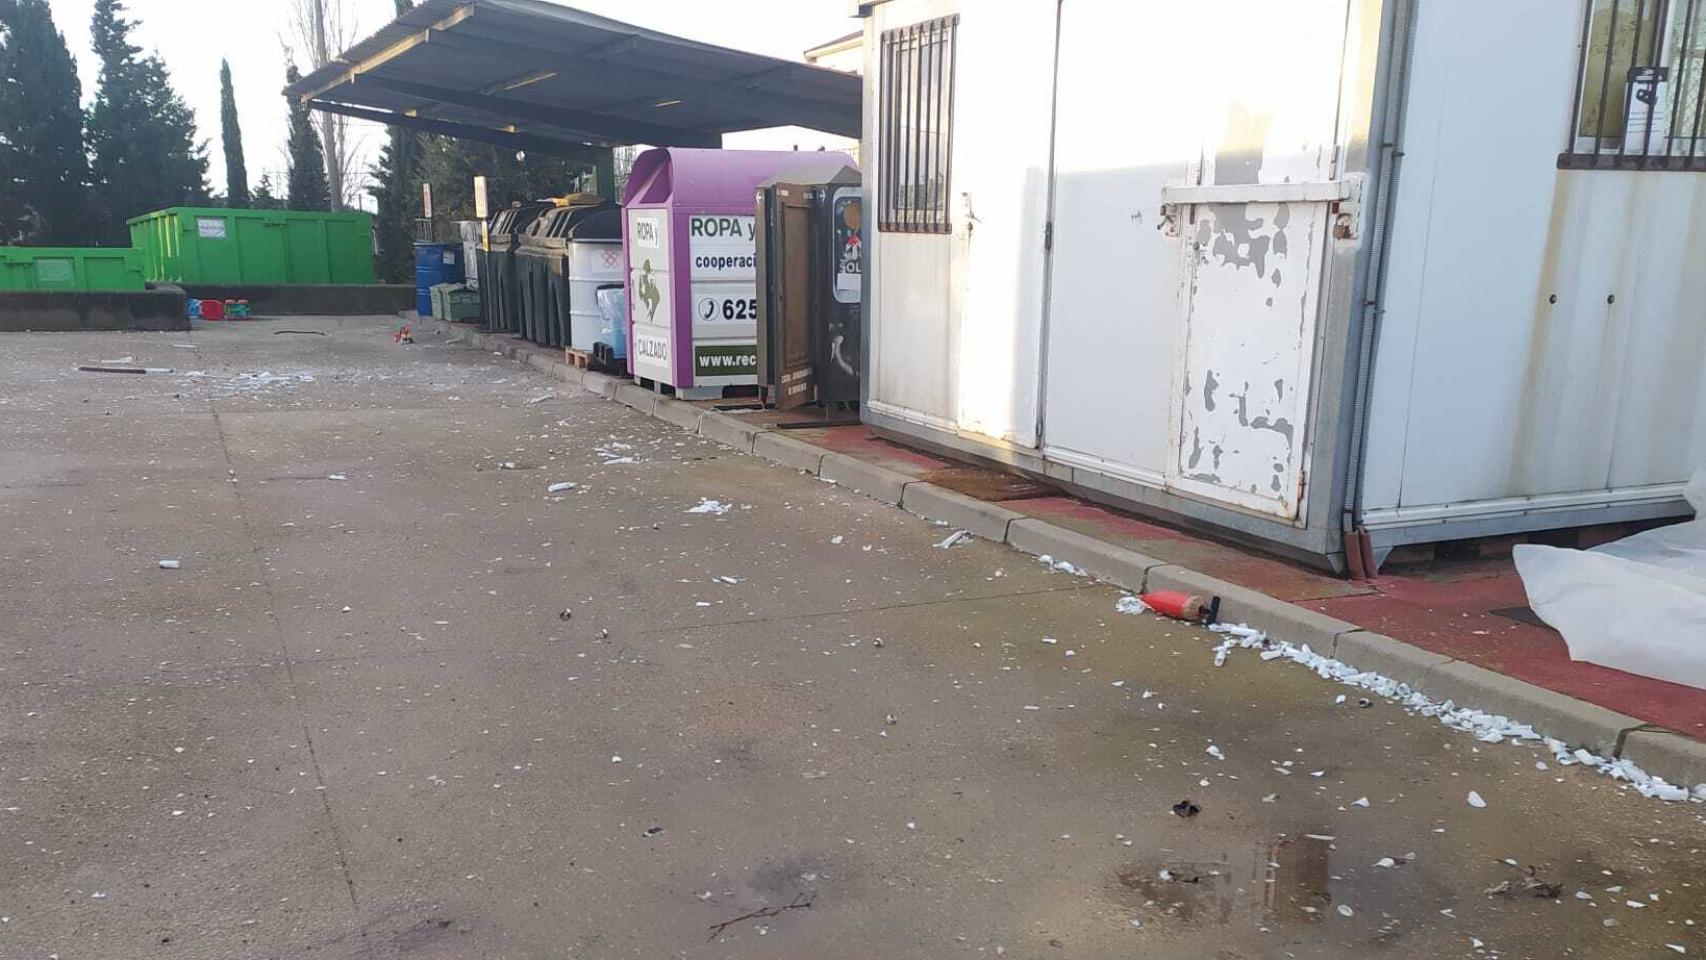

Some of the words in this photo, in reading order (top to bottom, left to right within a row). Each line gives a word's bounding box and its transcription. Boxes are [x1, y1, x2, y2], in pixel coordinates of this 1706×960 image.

[637, 222, 653, 241] ROPA
[691, 218, 742, 237] ROPA
[748, 223, 755, 241] y
[722, 299, 756, 320] 625
[638, 339, 667, 360] CALZADO
[699, 355, 756, 367] www.rec
